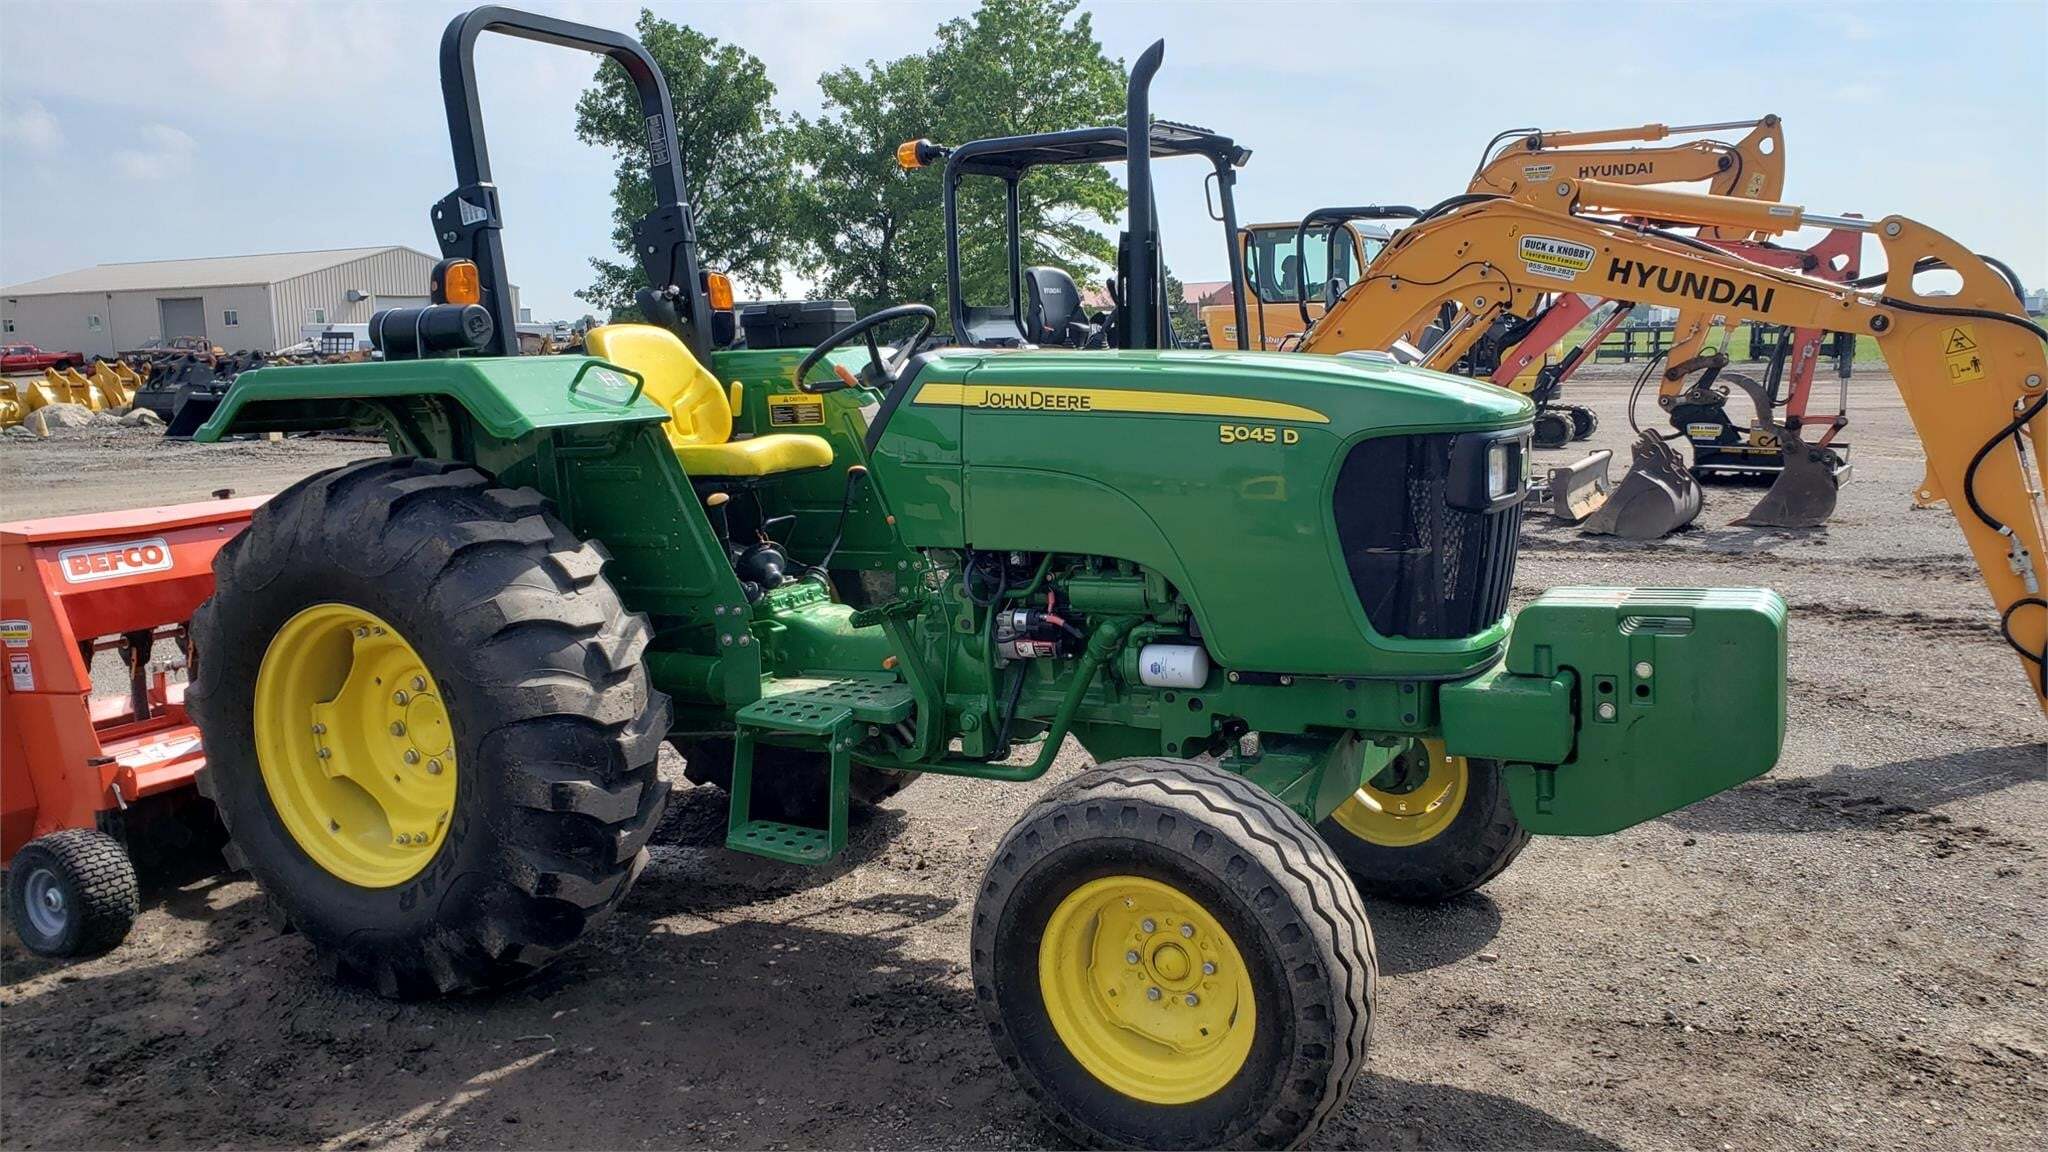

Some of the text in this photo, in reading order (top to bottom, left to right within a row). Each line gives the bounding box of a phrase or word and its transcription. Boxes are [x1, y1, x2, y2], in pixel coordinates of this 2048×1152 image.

[1578, 161, 1654, 178] HYUNDAI
[1524, 239, 1591, 260] BUCK & KNOBBY
[1606, 257, 1776, 314] HYUNDAI
[1219, 424, 1299, 444] 5045 D
[67, 545, 164, 576] BEFCO
